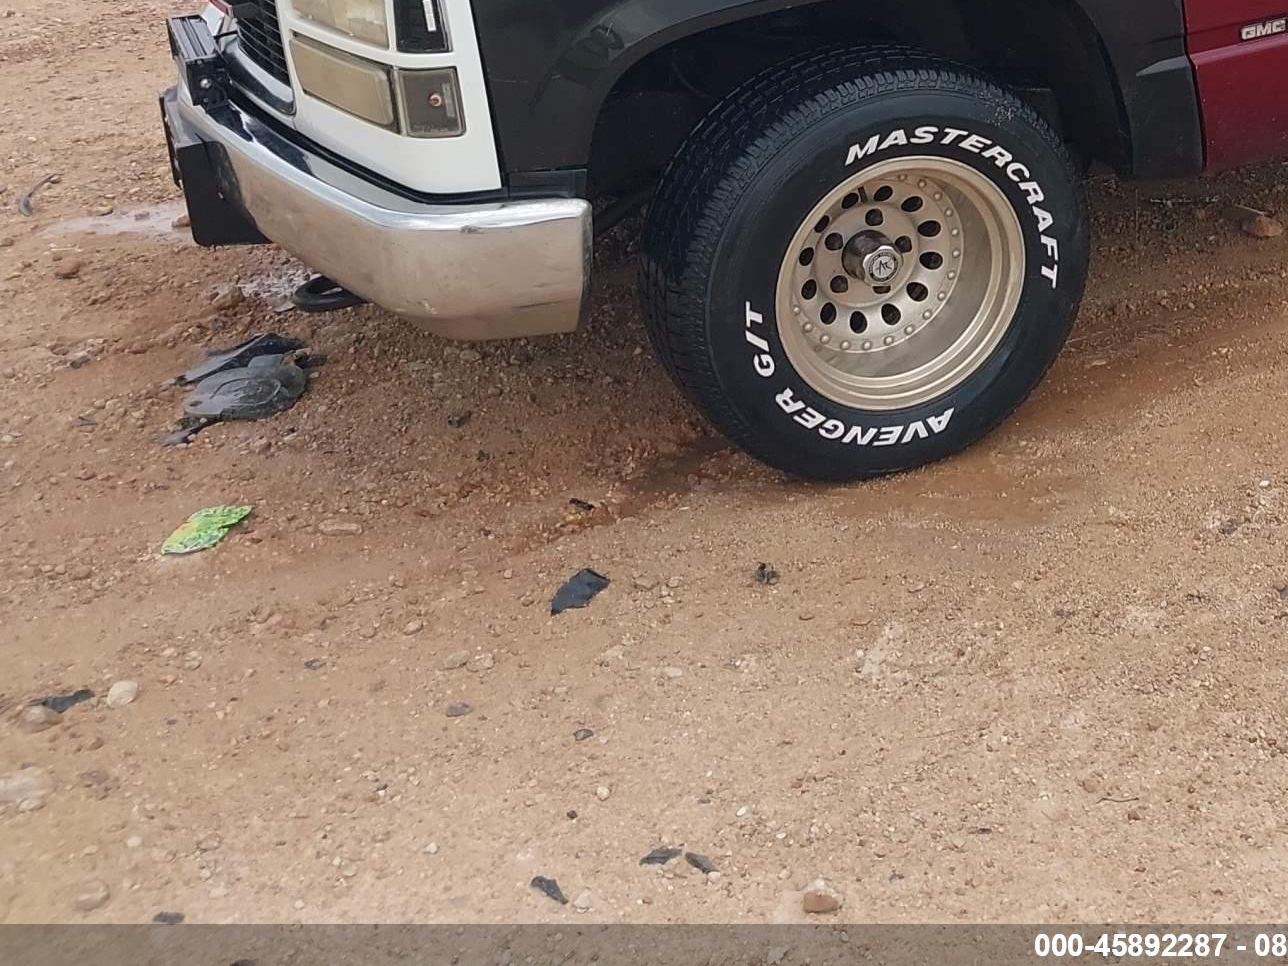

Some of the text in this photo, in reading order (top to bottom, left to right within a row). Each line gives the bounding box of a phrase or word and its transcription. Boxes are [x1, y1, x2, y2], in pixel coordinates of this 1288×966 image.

[1240, 17, 1287, 40] GMC
[844, 125, 1063, 290] MASTERCRAFT
[774, 387, 955, 447] AVENGER
